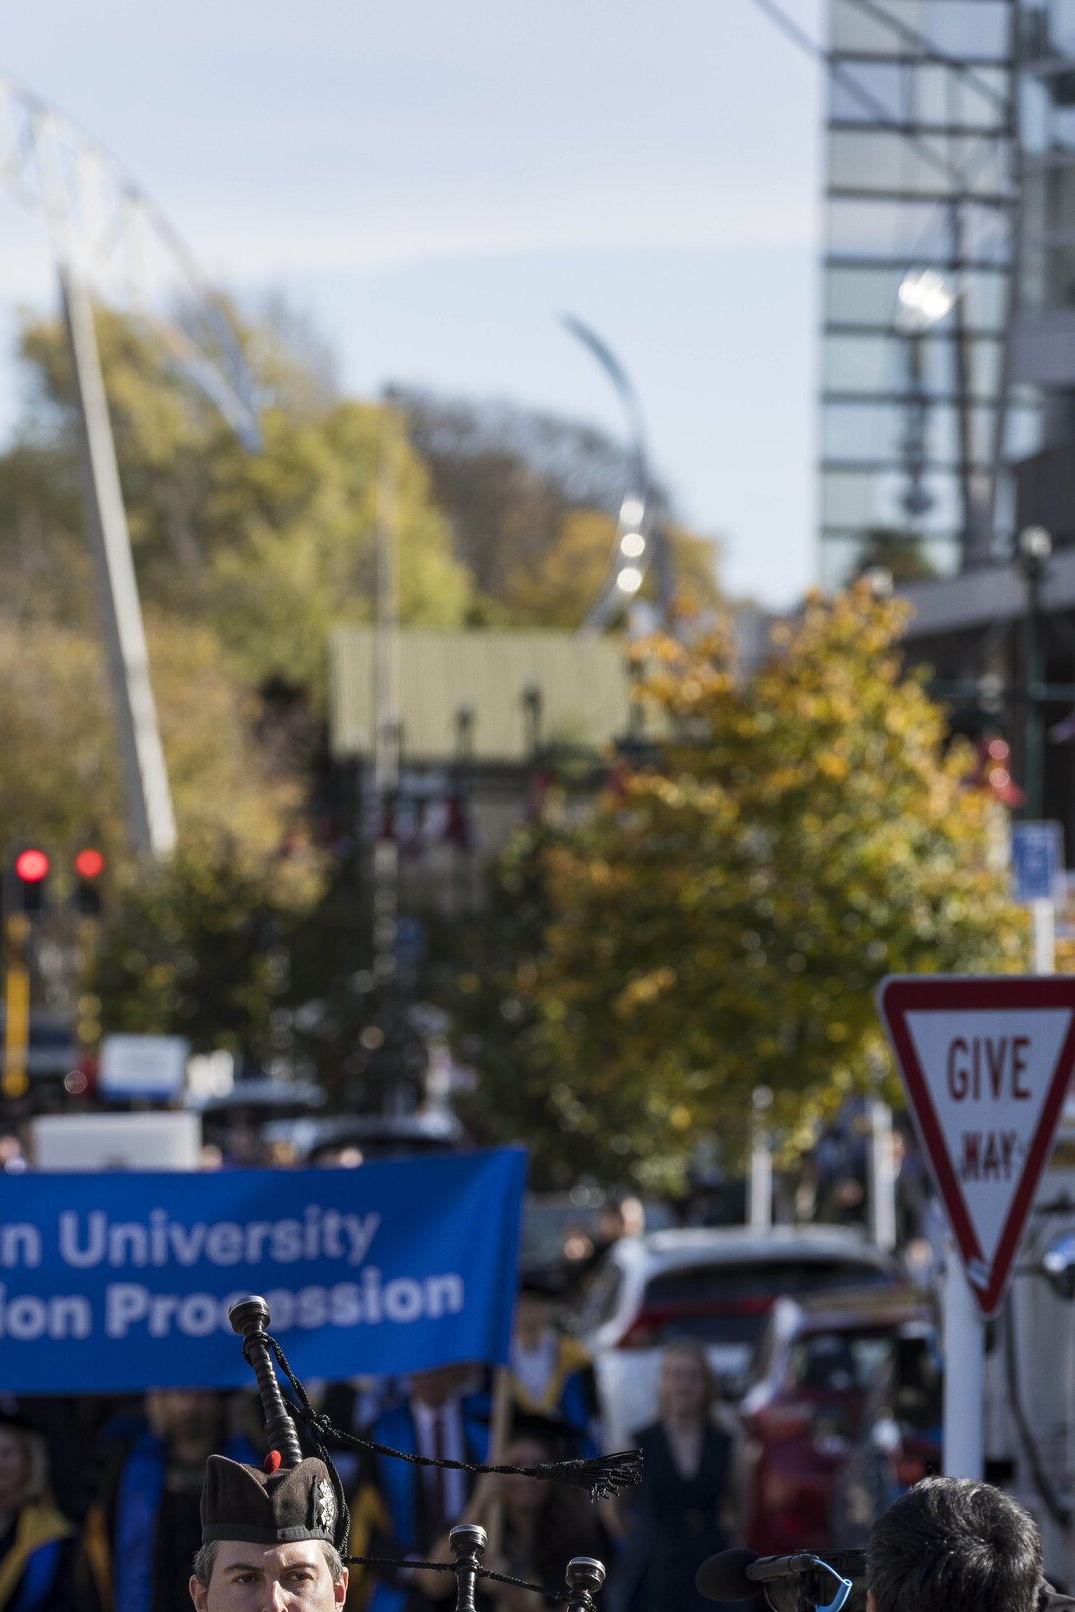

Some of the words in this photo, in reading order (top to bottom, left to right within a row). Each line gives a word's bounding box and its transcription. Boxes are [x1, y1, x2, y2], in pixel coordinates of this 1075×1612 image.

[948, 1037, 1030, 1101] GIVE
[962, 1131, 1016, 1181] WAY
[60, 1204, 381, 1267] University
